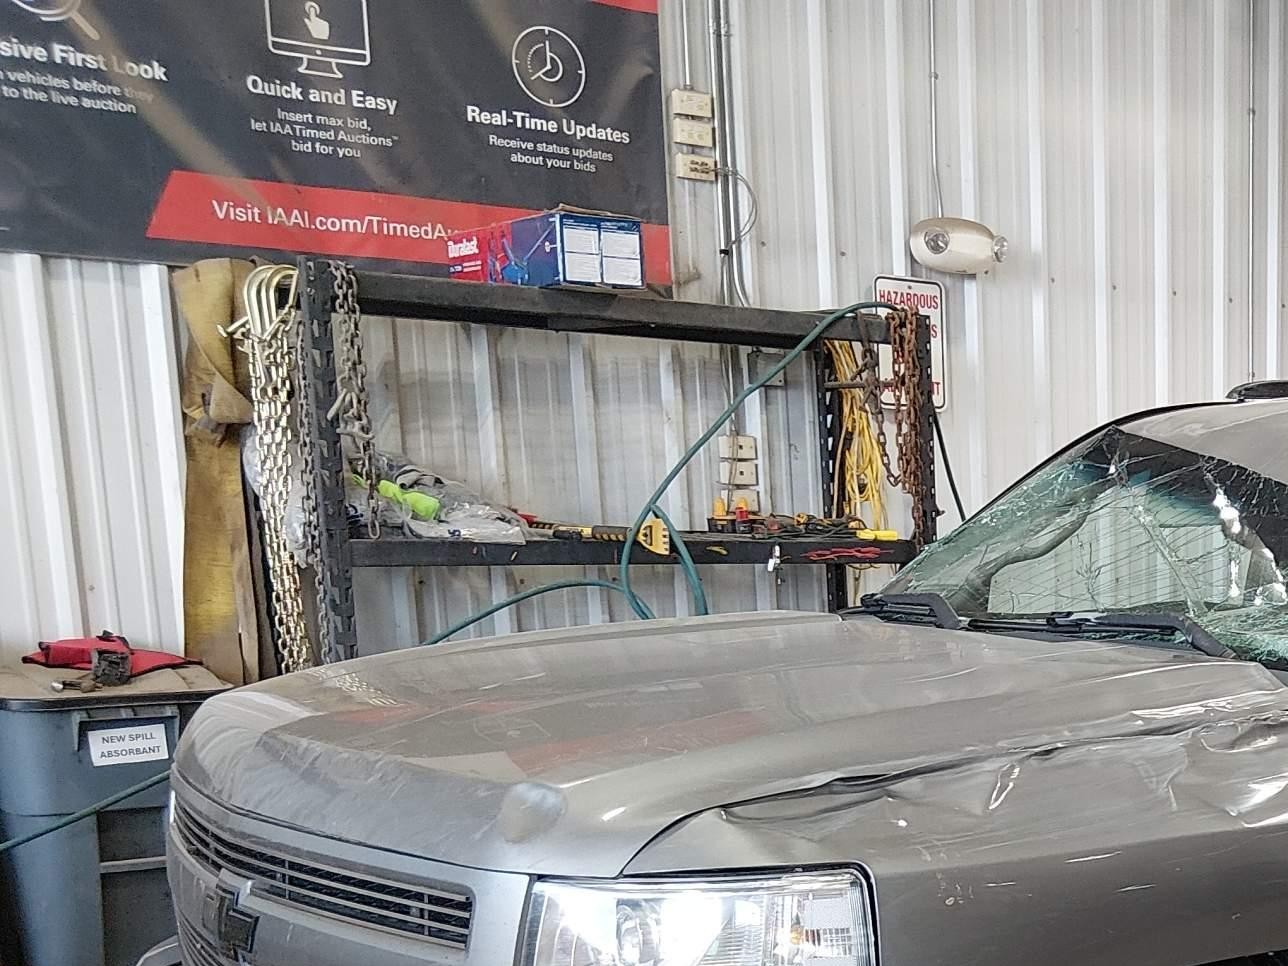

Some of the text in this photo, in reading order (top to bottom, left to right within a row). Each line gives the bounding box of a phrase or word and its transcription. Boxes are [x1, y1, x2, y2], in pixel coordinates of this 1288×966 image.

[53, 43, 108, 71] First
[112, 55, 169, 81] Look
[7, 71, 70, 89] vehicles
[72, 77, 122, 96] before
[247, 75, 398, 115] Quick and Easy
[2, 86, 137, 113] to the live auction
[251, 118, 267, 132] let
[277, 108, 372, 131] Insert max bid,
[466, 105, 631, 144] Real-Time Updates
[291, 140, 361, 158] bid for you
[488, 135, 614, 162] Receive status updates
[510, 152, 597, 173] about your bids
[212, 200, 459, 240] Visit IAAI.com/TimedA
[879, 289, 939, 310] HAZARDOUS
[102, 732, 156, 744] NEW SPILL
[100, 745, 161, 759] ABSORBANT
